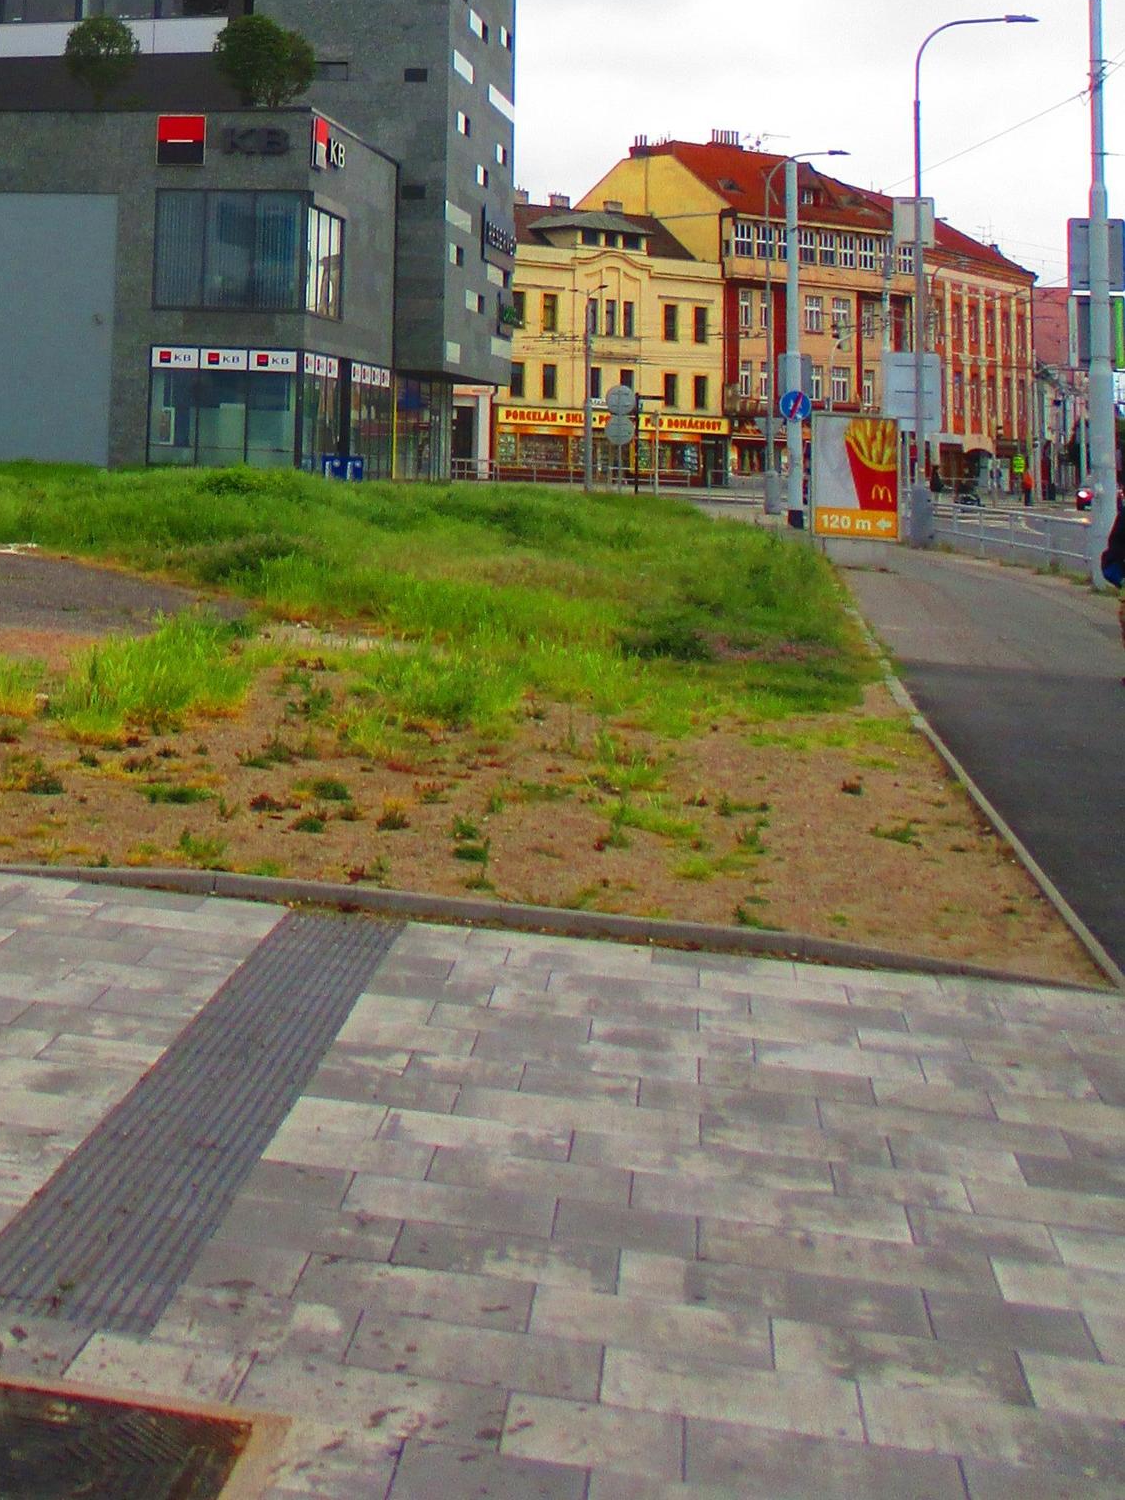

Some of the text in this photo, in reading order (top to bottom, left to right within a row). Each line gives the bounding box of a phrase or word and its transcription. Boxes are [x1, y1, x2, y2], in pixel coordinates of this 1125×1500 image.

[223, 127, 290, 154] KB
[329, 138, 346, 168] KB
[174, 354, 192, 362] KB
[222, 355, 240, 363] KB
[271, 357, 290, 365] KB
[505, 409, 557, 422] PORCELÁN
[822, 514, 871, 531] 120 m
